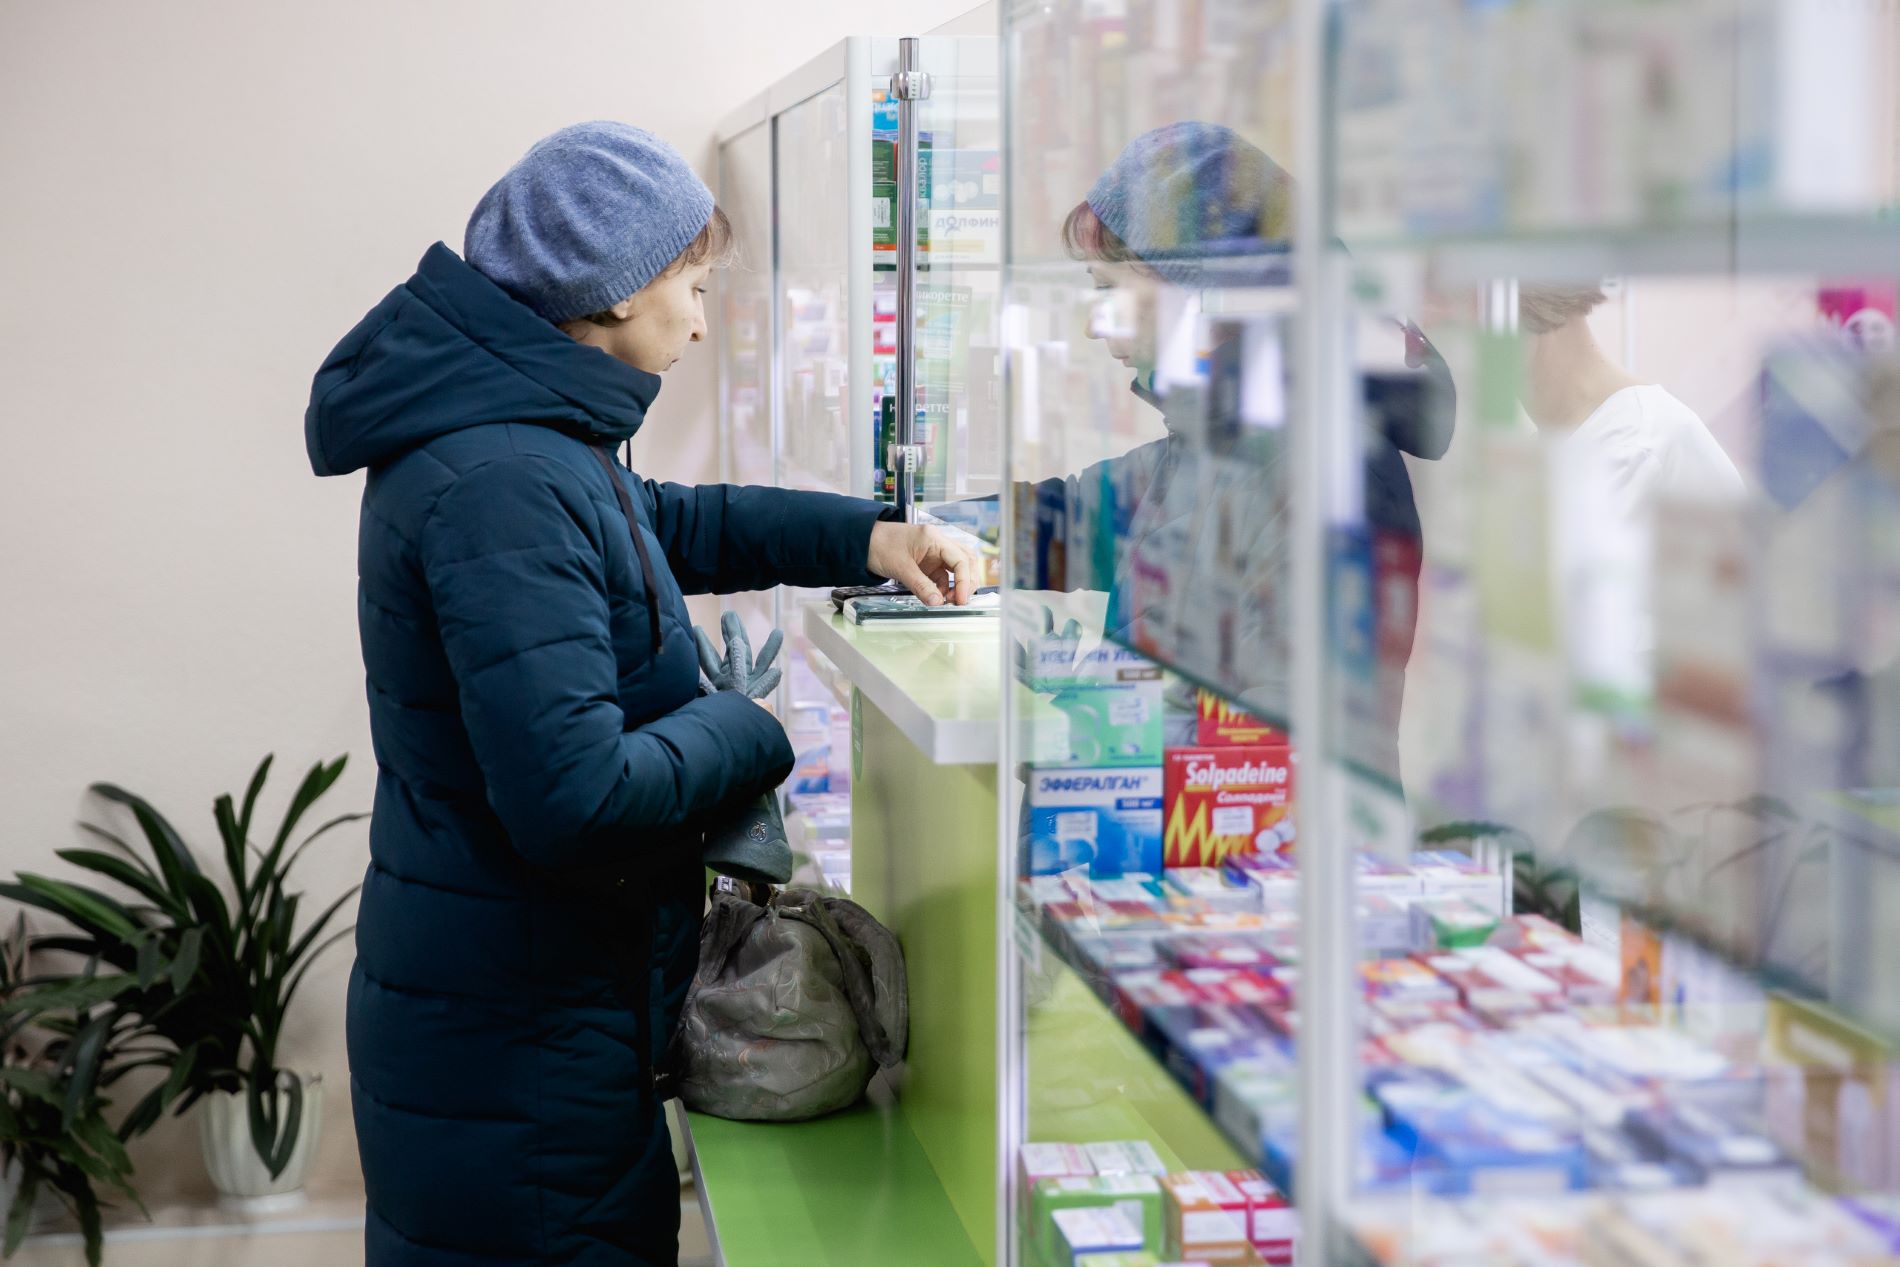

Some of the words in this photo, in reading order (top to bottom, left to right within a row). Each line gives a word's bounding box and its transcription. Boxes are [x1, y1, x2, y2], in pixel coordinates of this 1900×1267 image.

[917, 290, 969, 304] икоретте
[1040, 775, 1141, 792] ЭФФЕРАЛГАН
[1185, 760, 1288, 791] Solpadeine
